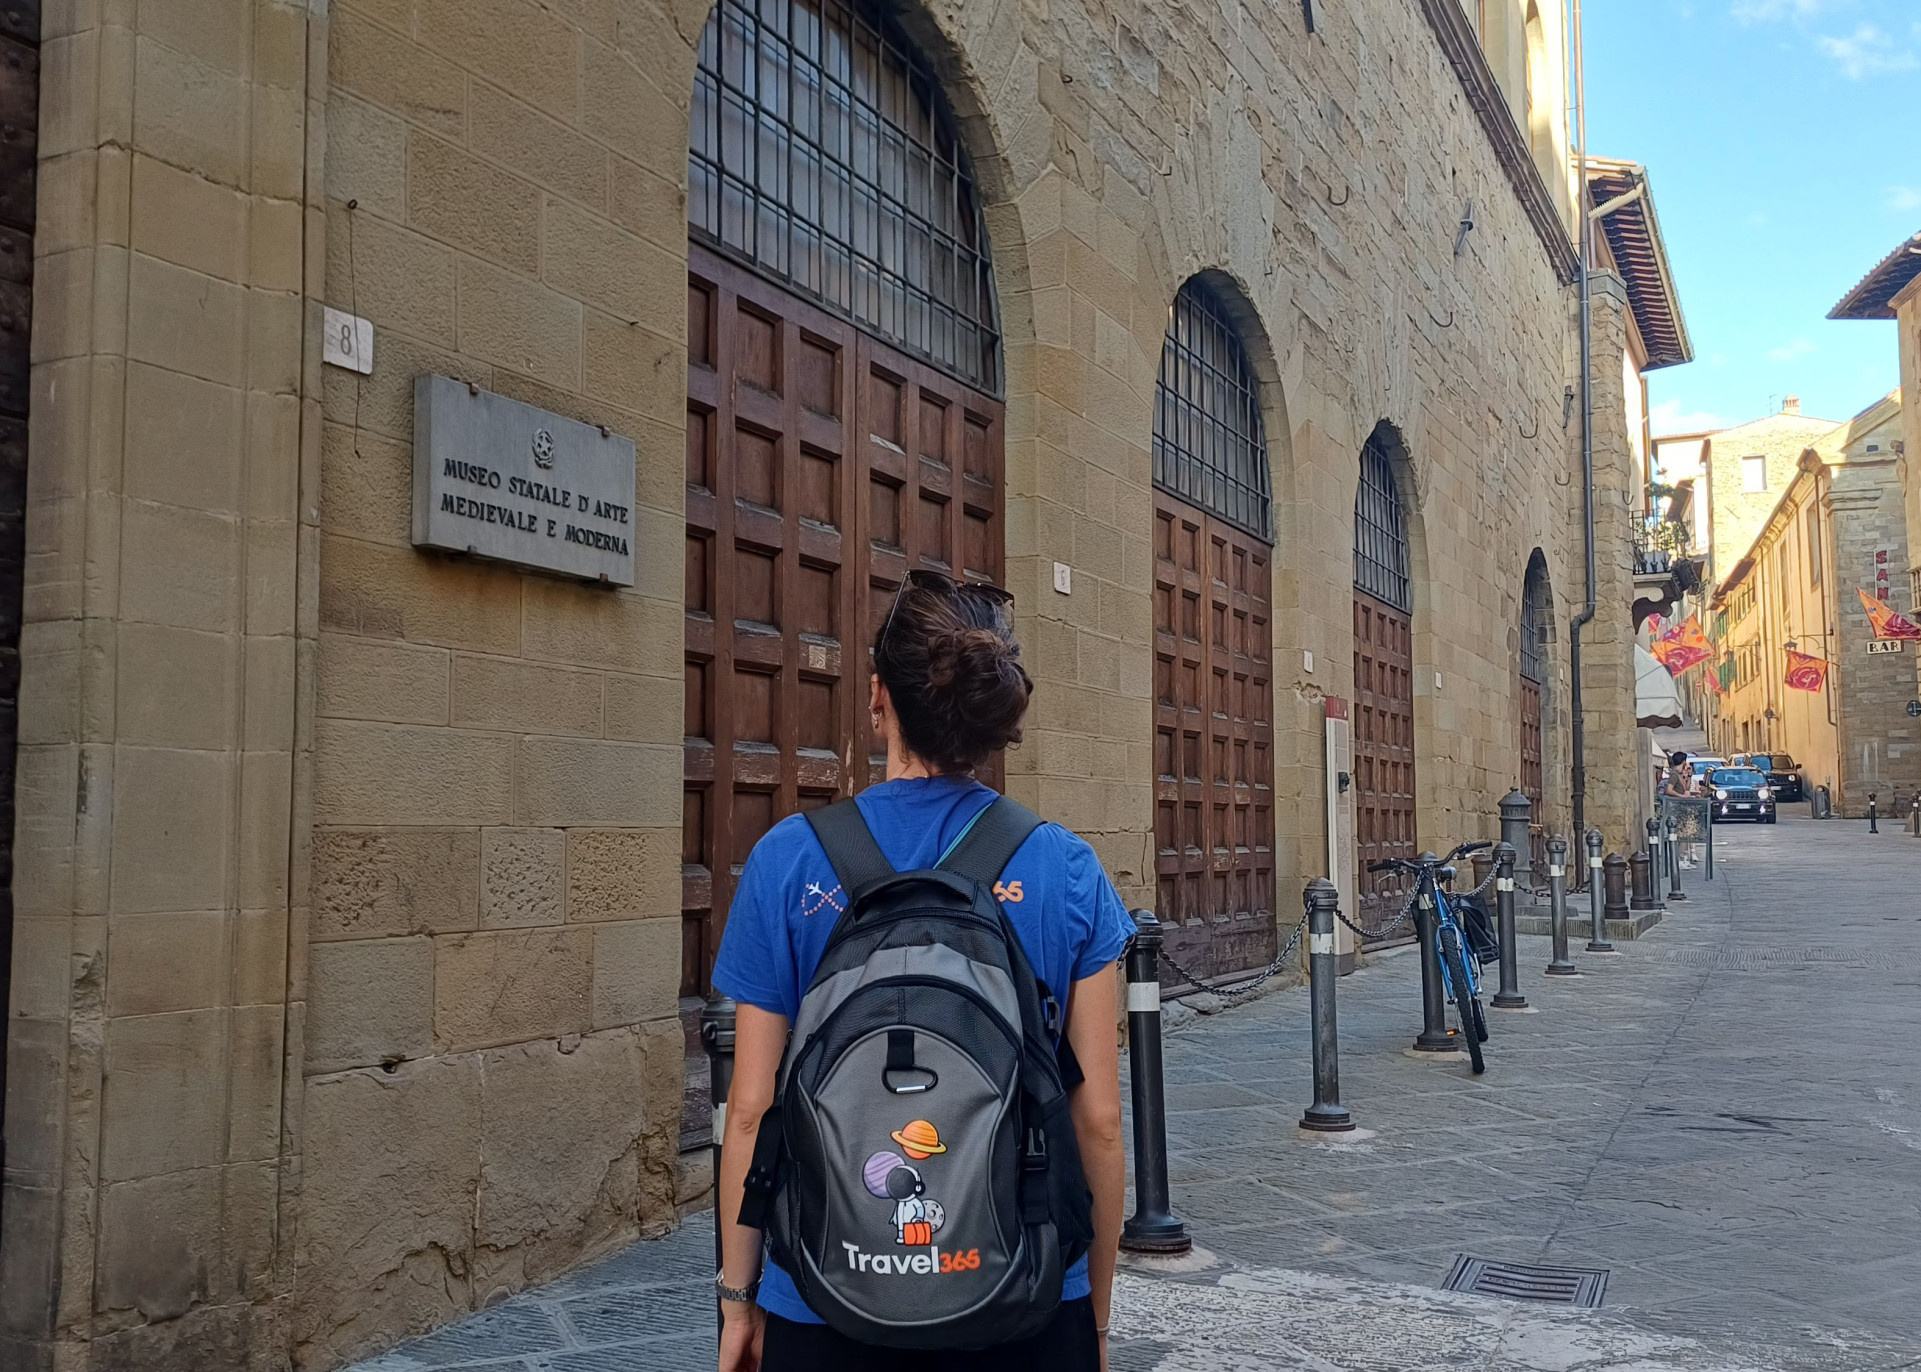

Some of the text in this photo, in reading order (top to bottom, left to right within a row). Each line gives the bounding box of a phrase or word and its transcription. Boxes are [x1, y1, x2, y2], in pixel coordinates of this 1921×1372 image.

[340, 324, 352, 356] 8
[443, 458, 501, 489] MUSEO
[508, 476, 571, 508] STATALE
[440, 493, 629, 556] MEDIEVALE E MODERNA
[1869, 641, 1900, 653] BAR
[842, 1240, 981, 1275] Travel365
